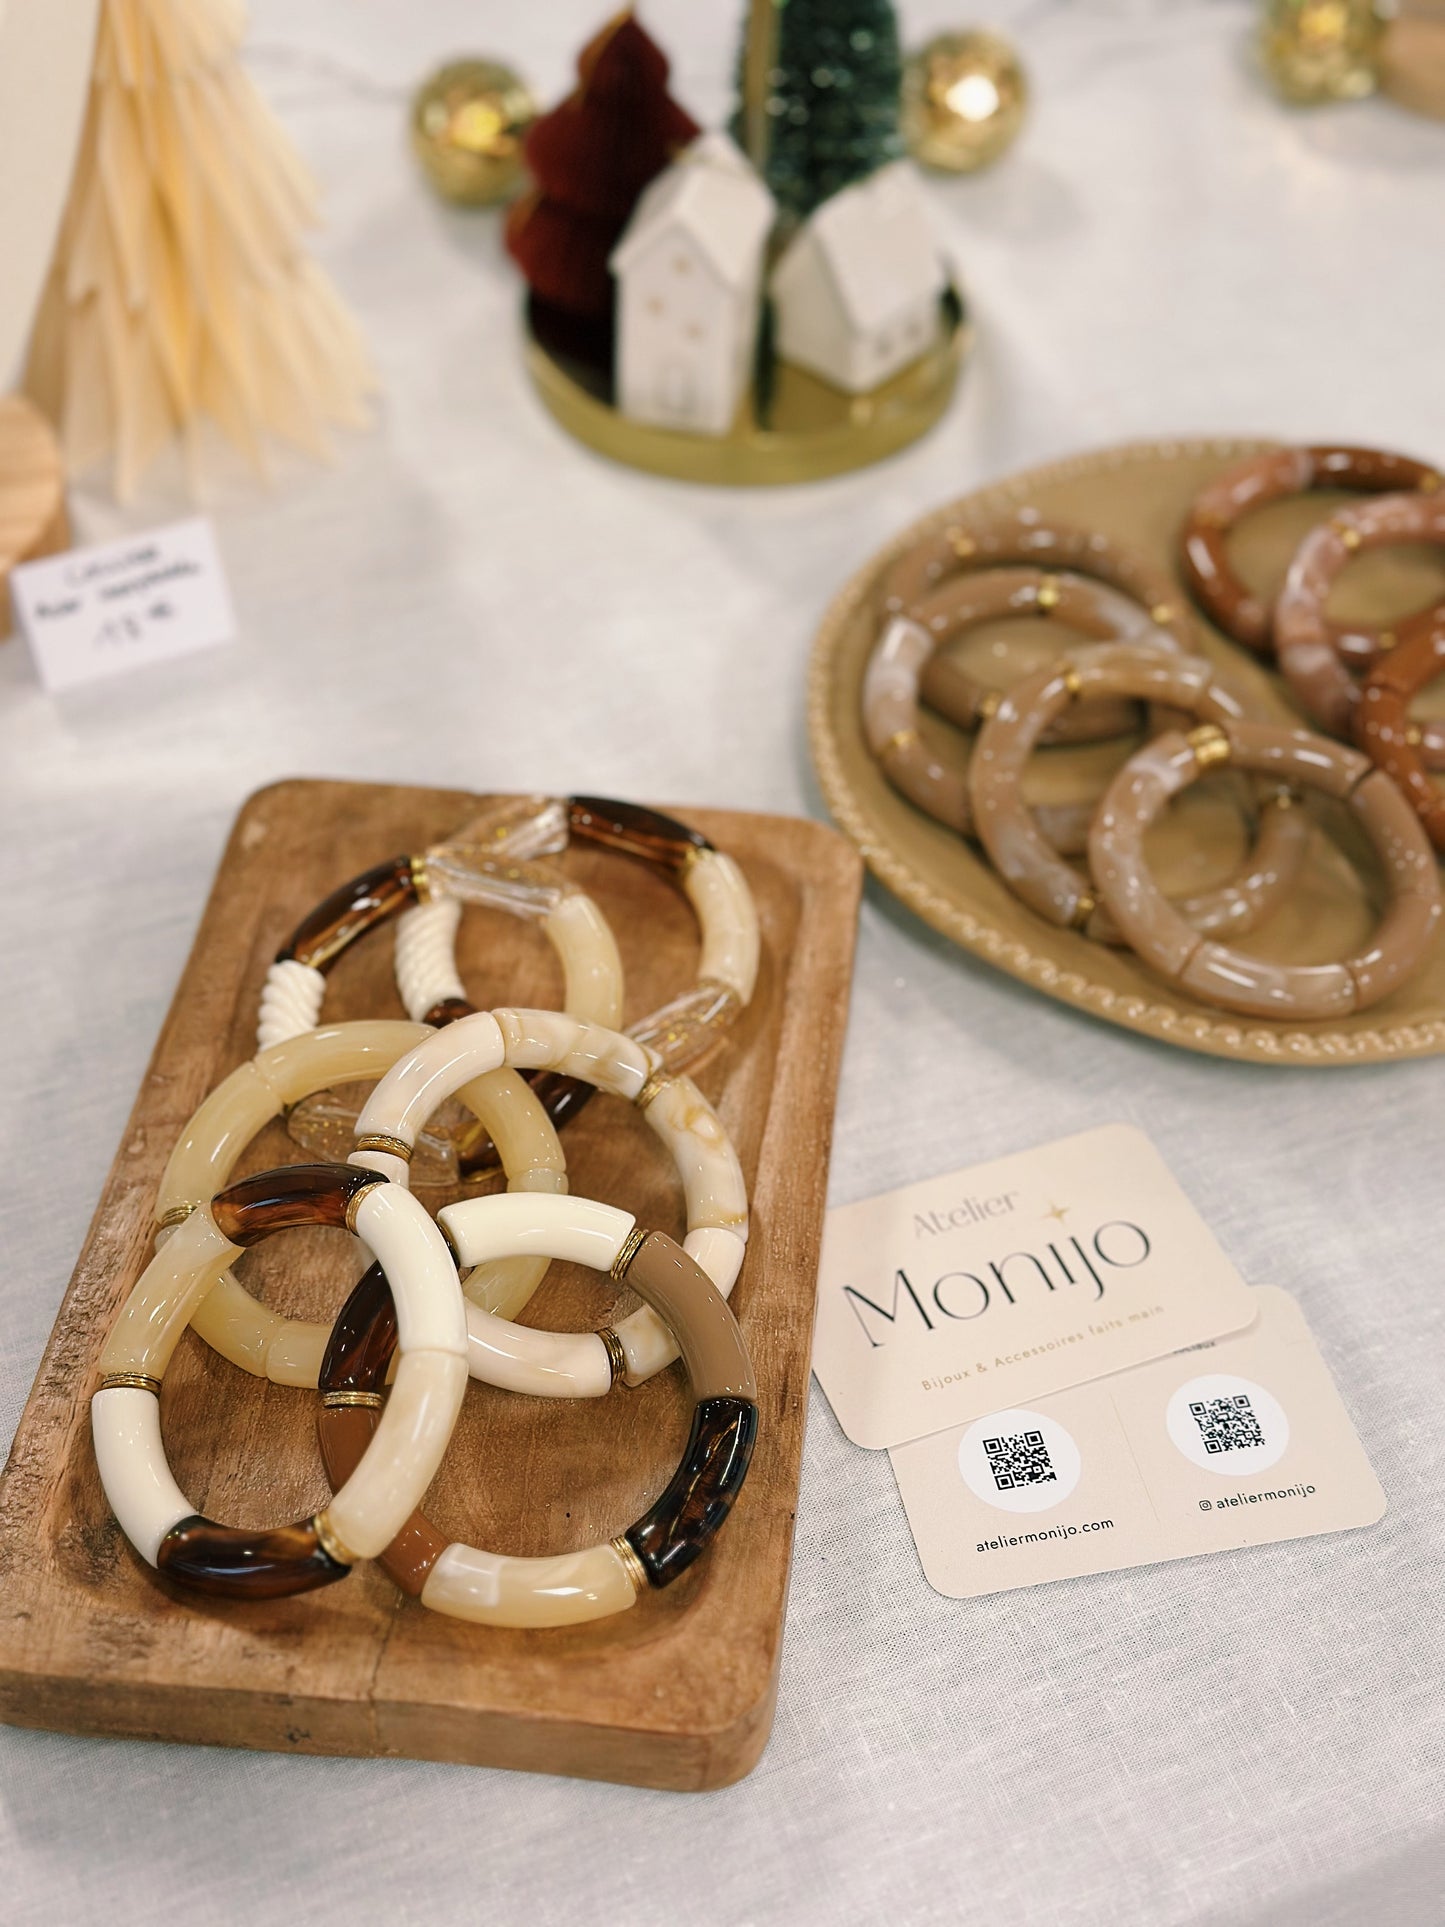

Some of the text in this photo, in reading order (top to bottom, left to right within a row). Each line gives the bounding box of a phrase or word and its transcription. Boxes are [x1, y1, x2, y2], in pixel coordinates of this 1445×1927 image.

[912, 1190, 1019, 1239] Atelier
[842, 1219, 1151, 1348] Monijo
[921, 1305, 1165, 1392] Bijoux & Accessoires faits main
[1216, 1483, 1316, 1510] ateliermonijo
[975, 1518, 1115, 1553] ateliermonijo.com
